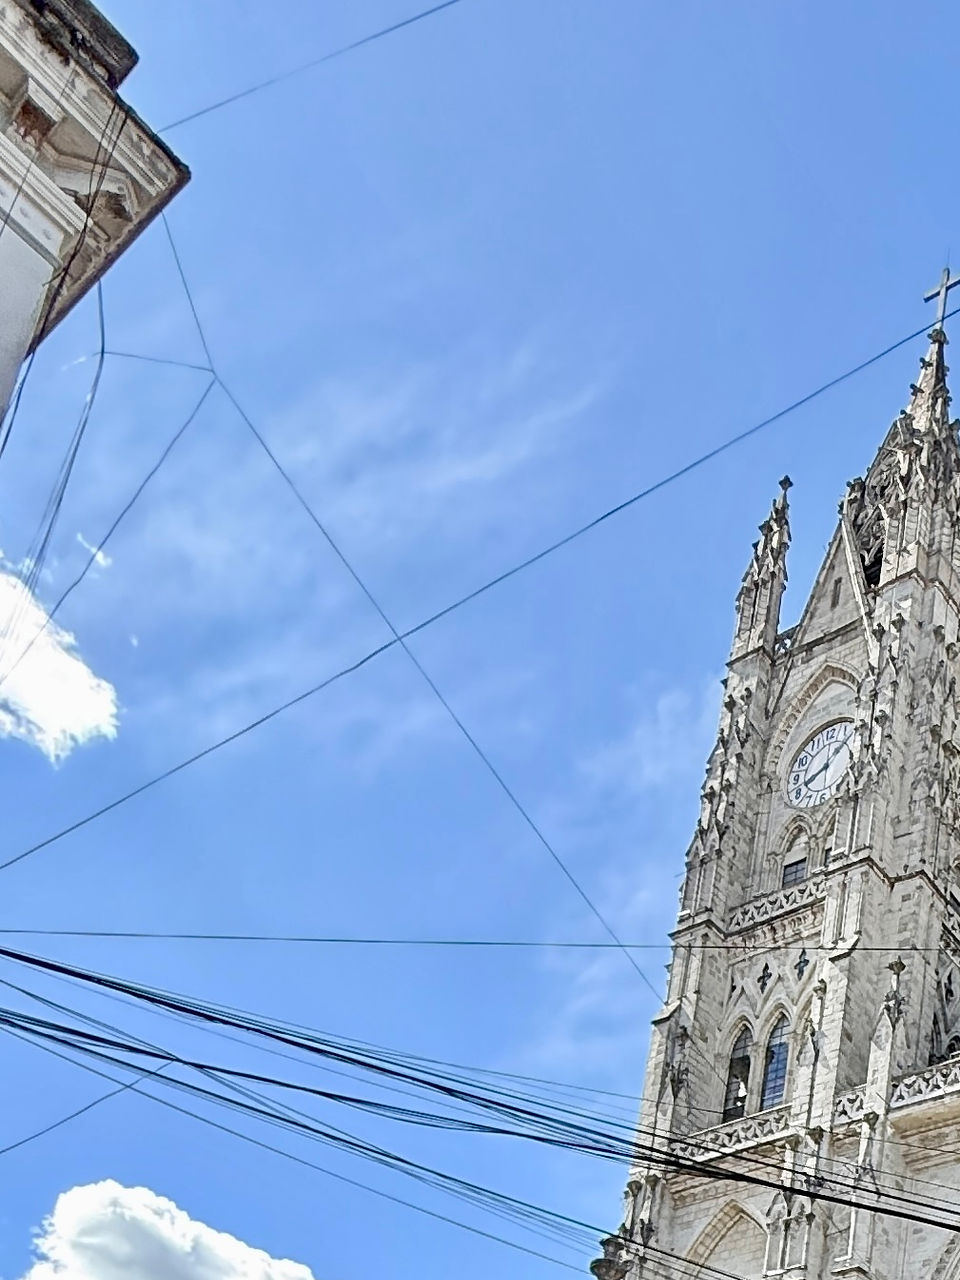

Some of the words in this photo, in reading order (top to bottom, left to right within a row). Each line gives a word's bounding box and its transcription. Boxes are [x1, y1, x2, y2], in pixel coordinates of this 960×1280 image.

[826, 729, 835, 741] 12
[812, 739, 820, 751] 11
[798, 756, 807, 768] 10
[793, 775, 799, 784] 9
[795, 788, 801, 799] 8
[820, 793, 826, 805] 6
[806, 796, 812, 806] 7
